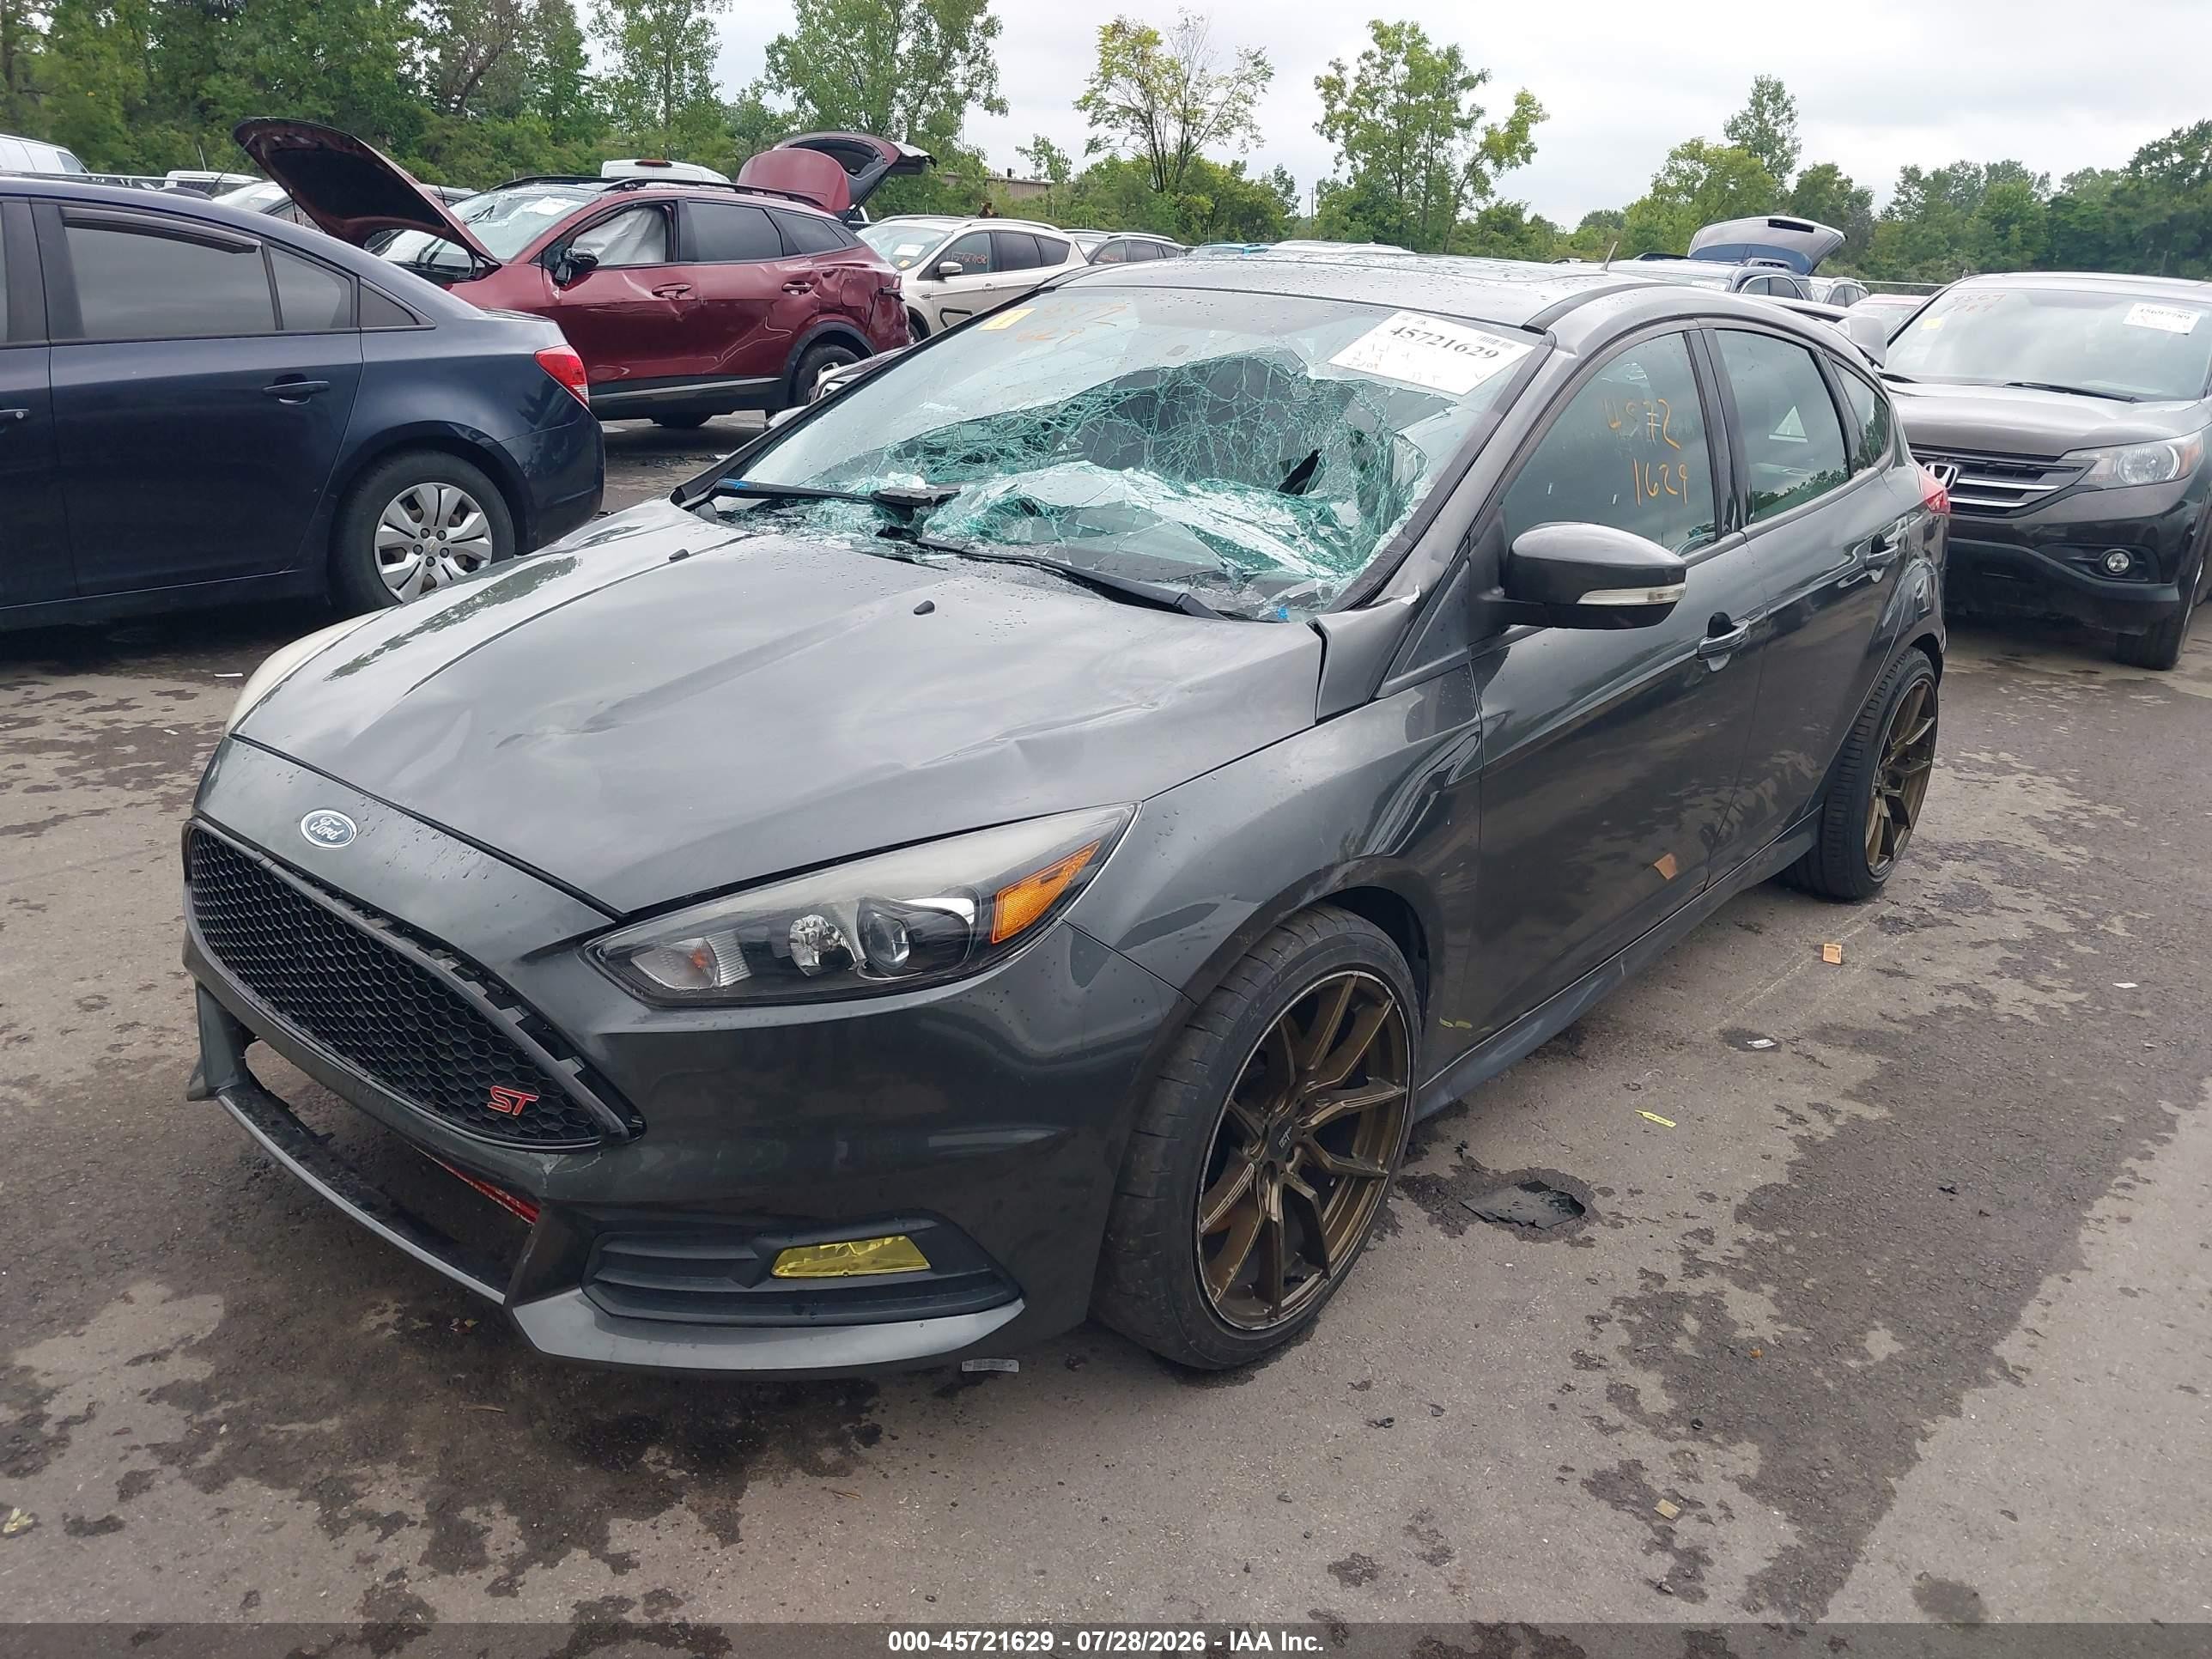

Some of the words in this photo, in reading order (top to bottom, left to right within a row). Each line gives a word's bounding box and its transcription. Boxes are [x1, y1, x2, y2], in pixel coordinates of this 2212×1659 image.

[1390, 326, 1500, 359] 45721629
[1633, 458, 1688, 506] 1629
[310, 817, 345, 841] Ford
[488, 1085, 539, 1115] ST
